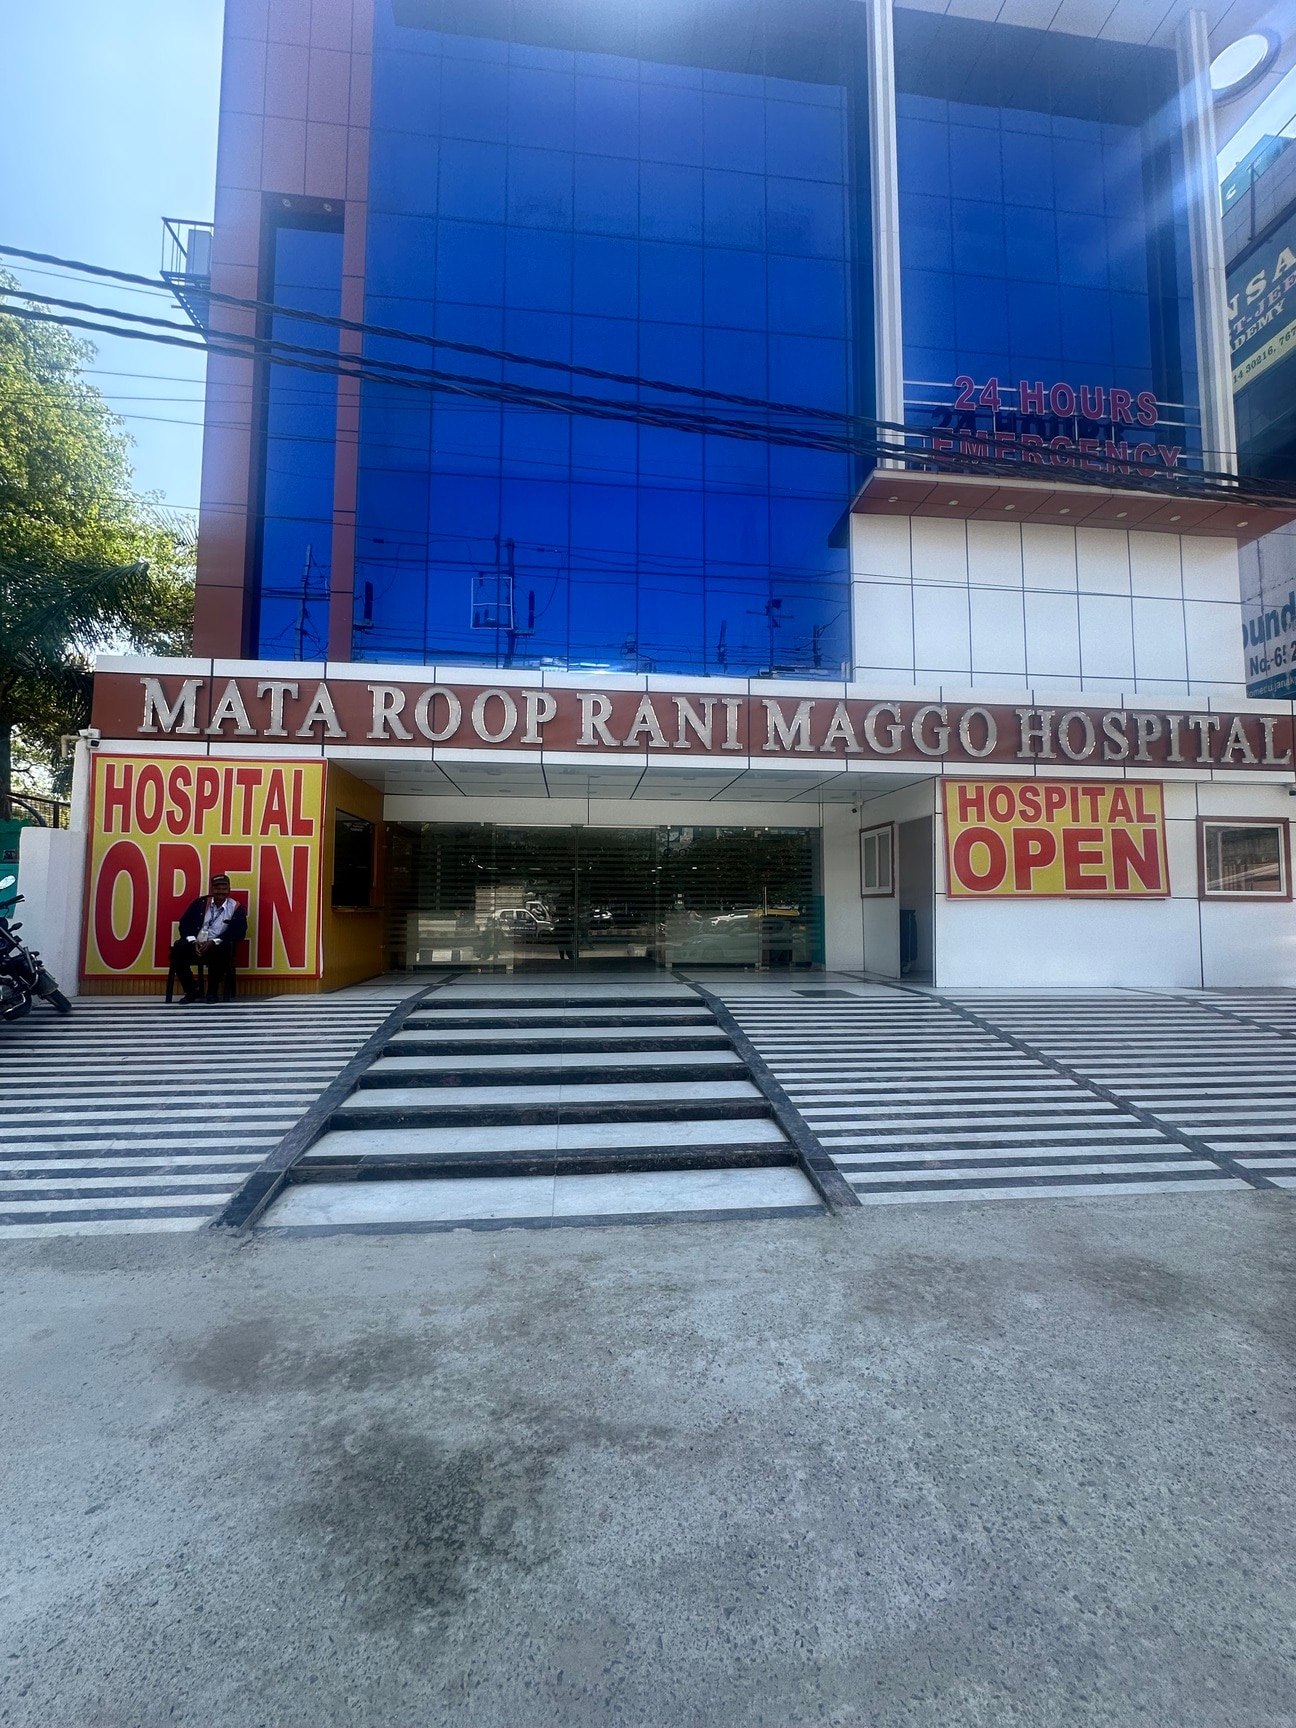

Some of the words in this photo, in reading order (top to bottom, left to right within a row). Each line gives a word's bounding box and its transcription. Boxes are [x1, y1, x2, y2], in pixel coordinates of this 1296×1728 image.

[954, 375, 1002, 413] 24
[1019, 380, 1159, 427] HOURS
[932, 427, 1183, 479] EMERGENCY
[137, 677, 347, 738] MATA
[366, 684, 558, 744] ROOP
[576, 692, 744, 750] RANI
[761, 699, 998, 758] MAGGO
[1015, 708, 1292, 765] HOSPITAL
[102, 763, 315, 837] HOSPITAL
[957, 784, 1157, 824] HOSPITAL
[953, 826, 1162, 893] OPEN
[94, 840, 311, 970] OPEN
